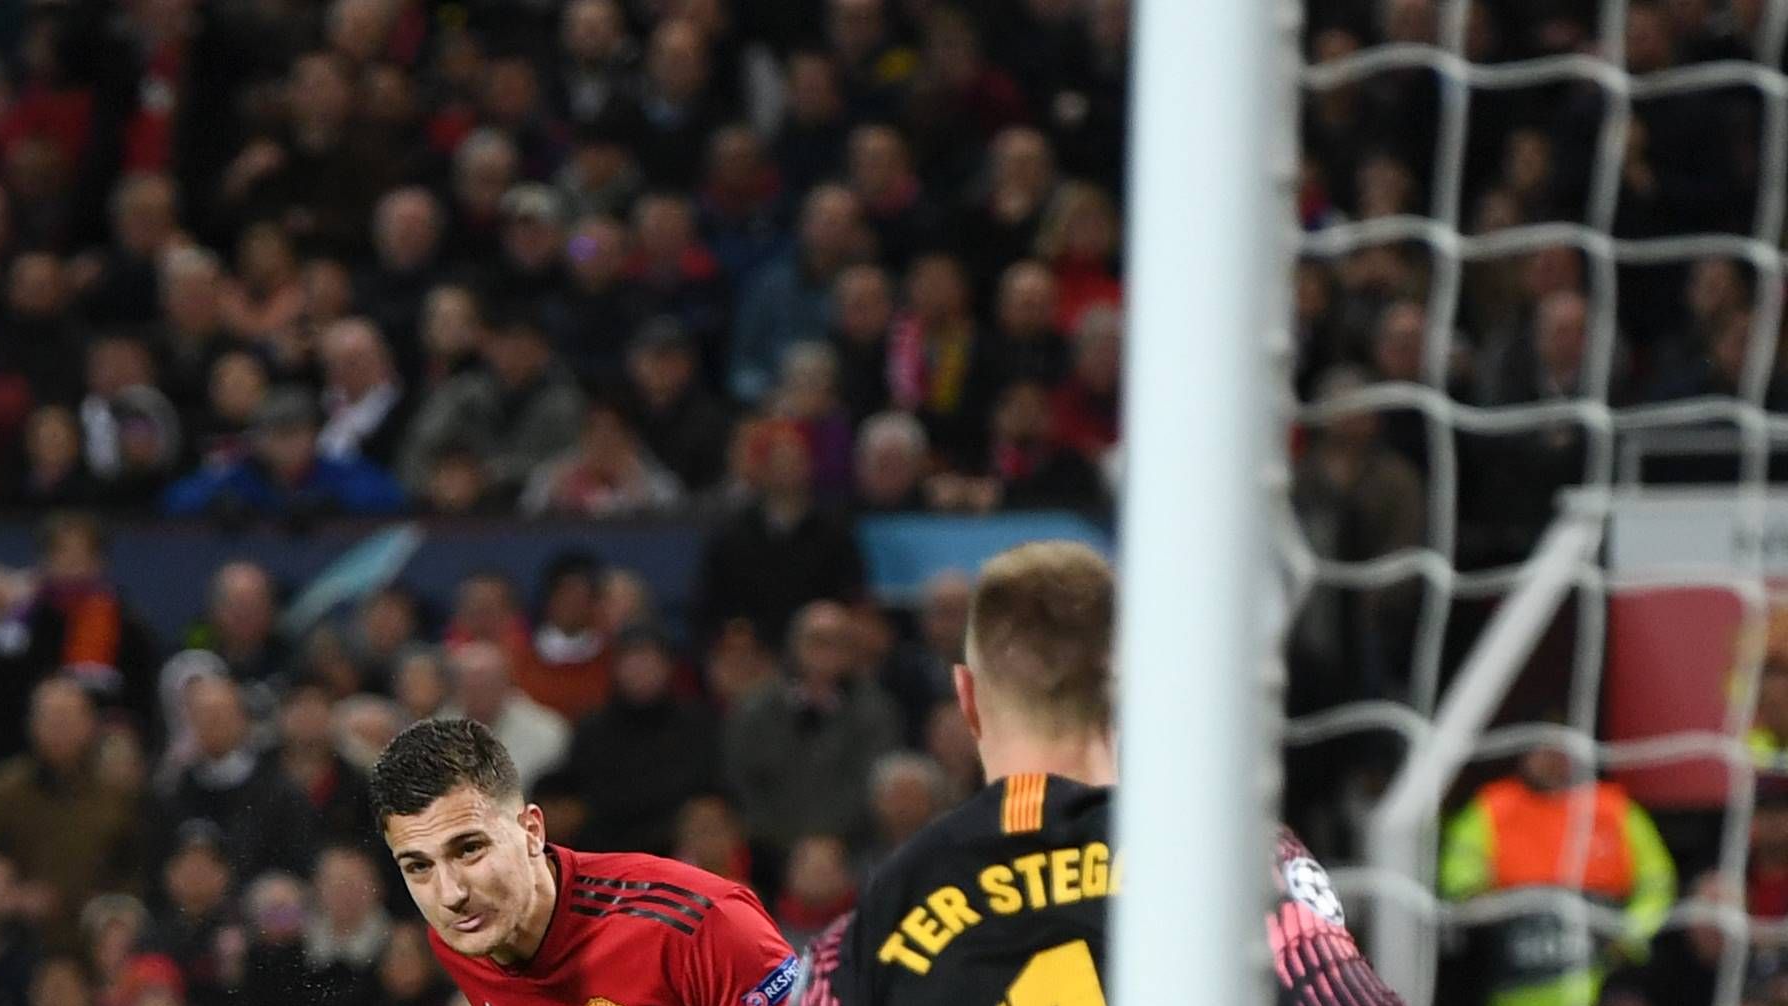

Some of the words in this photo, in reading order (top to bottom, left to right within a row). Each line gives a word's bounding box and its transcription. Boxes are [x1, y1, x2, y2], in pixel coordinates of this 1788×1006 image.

[877, 885, 983, 976] TER
[978, 841, 1125, 915] STEG
[764, 959, 801, 999] RESPE
